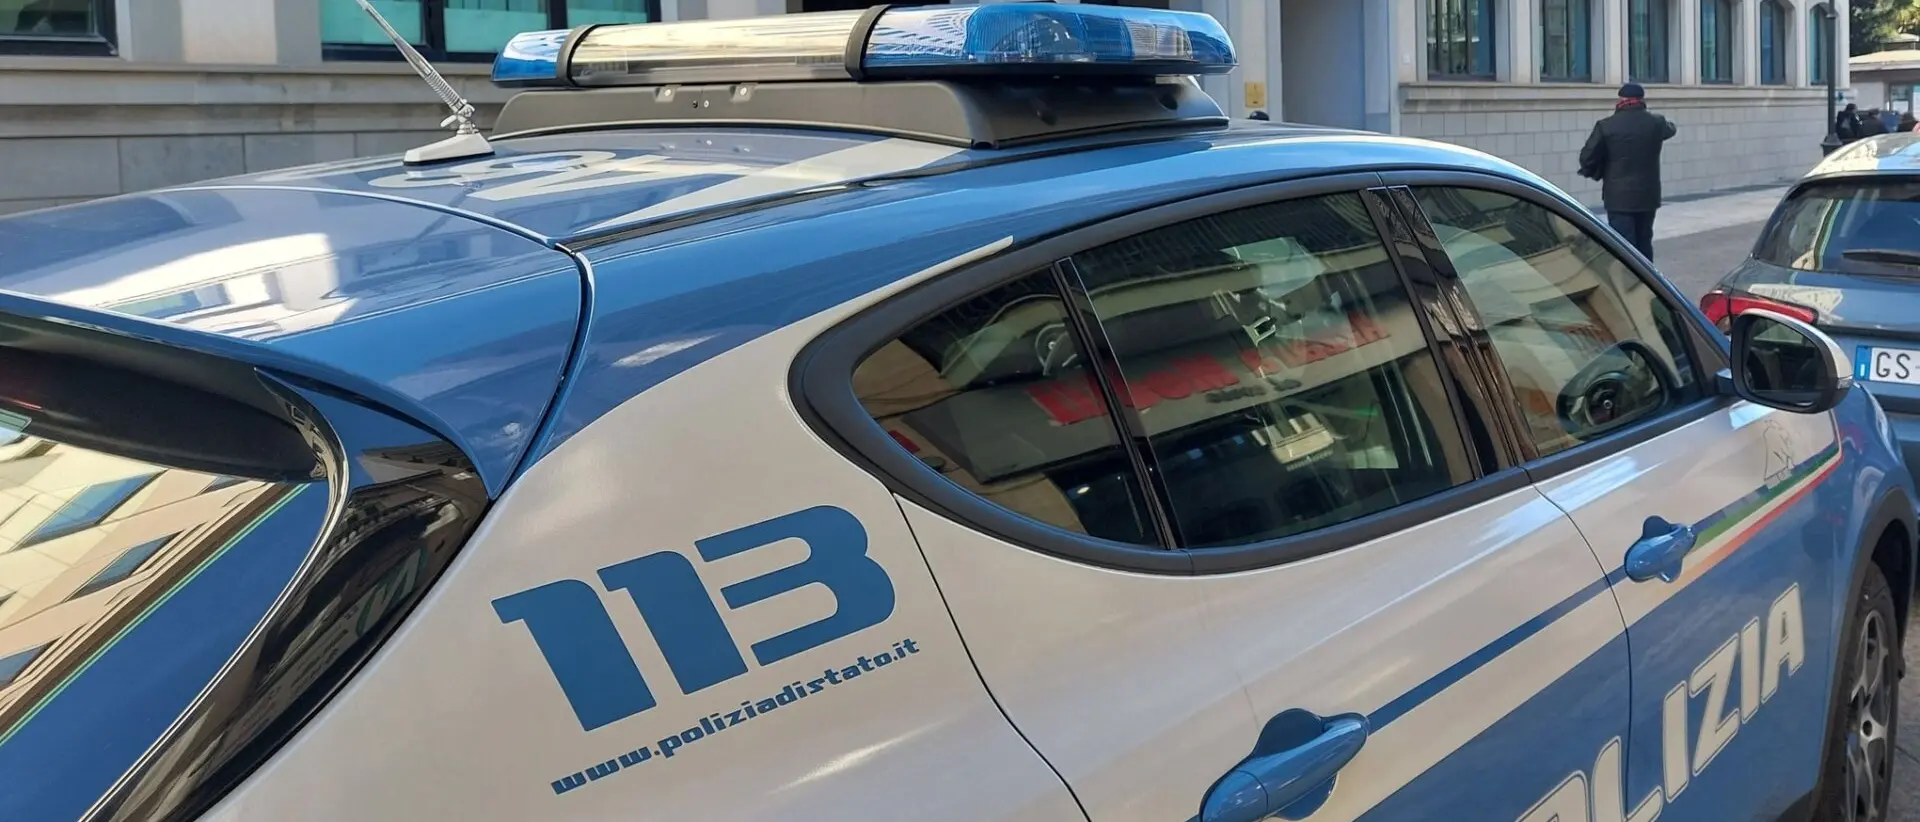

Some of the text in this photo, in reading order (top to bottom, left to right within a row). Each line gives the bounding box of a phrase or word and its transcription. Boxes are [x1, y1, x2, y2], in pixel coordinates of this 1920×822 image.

[1876, 351, 1911, 379] GS
[491, 505, 896, 732] 113
[550, 637, 920, 795] www.poliziadistato.it
